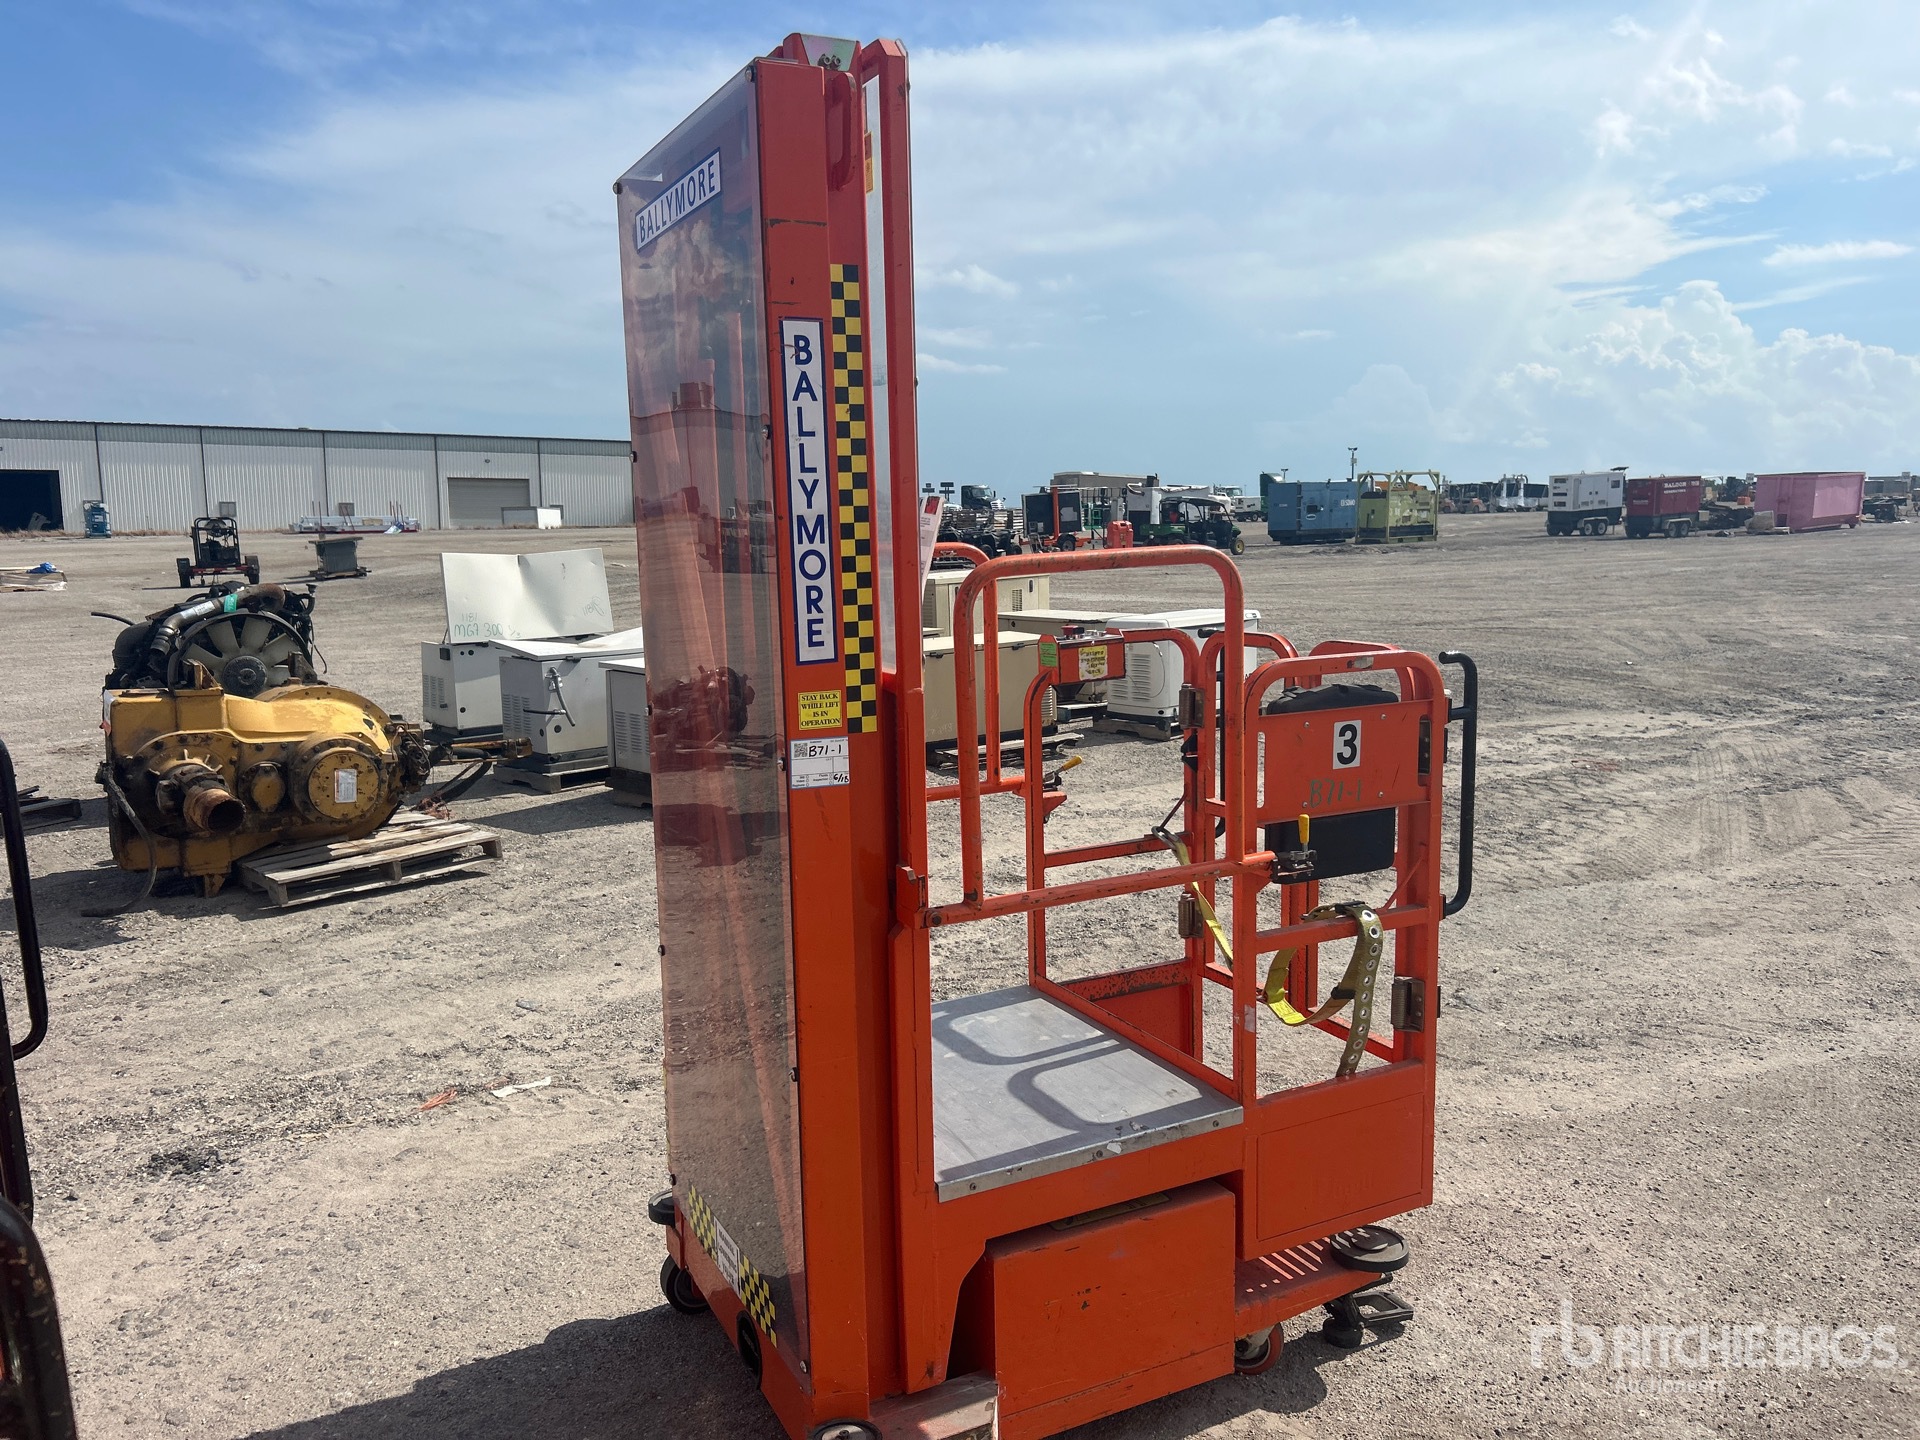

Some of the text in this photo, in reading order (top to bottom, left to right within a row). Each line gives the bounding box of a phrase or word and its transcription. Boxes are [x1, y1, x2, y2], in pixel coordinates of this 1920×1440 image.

[639, 159, 716, 244] BALLYMORE
[792, 334, 827, 648] BALLYMORE
[483, 622, 504, 637] 300
[801, 692, 839, 702] STAY BACK
[801, 700, 839, 710] WHILE LIFT
[801, 718, 841, 727] OPERATION
[808, 744, 842, 757] B71-1
[1336, 723, 1358, 765] 3
[1309, 778, 1363, 808] B71-1
